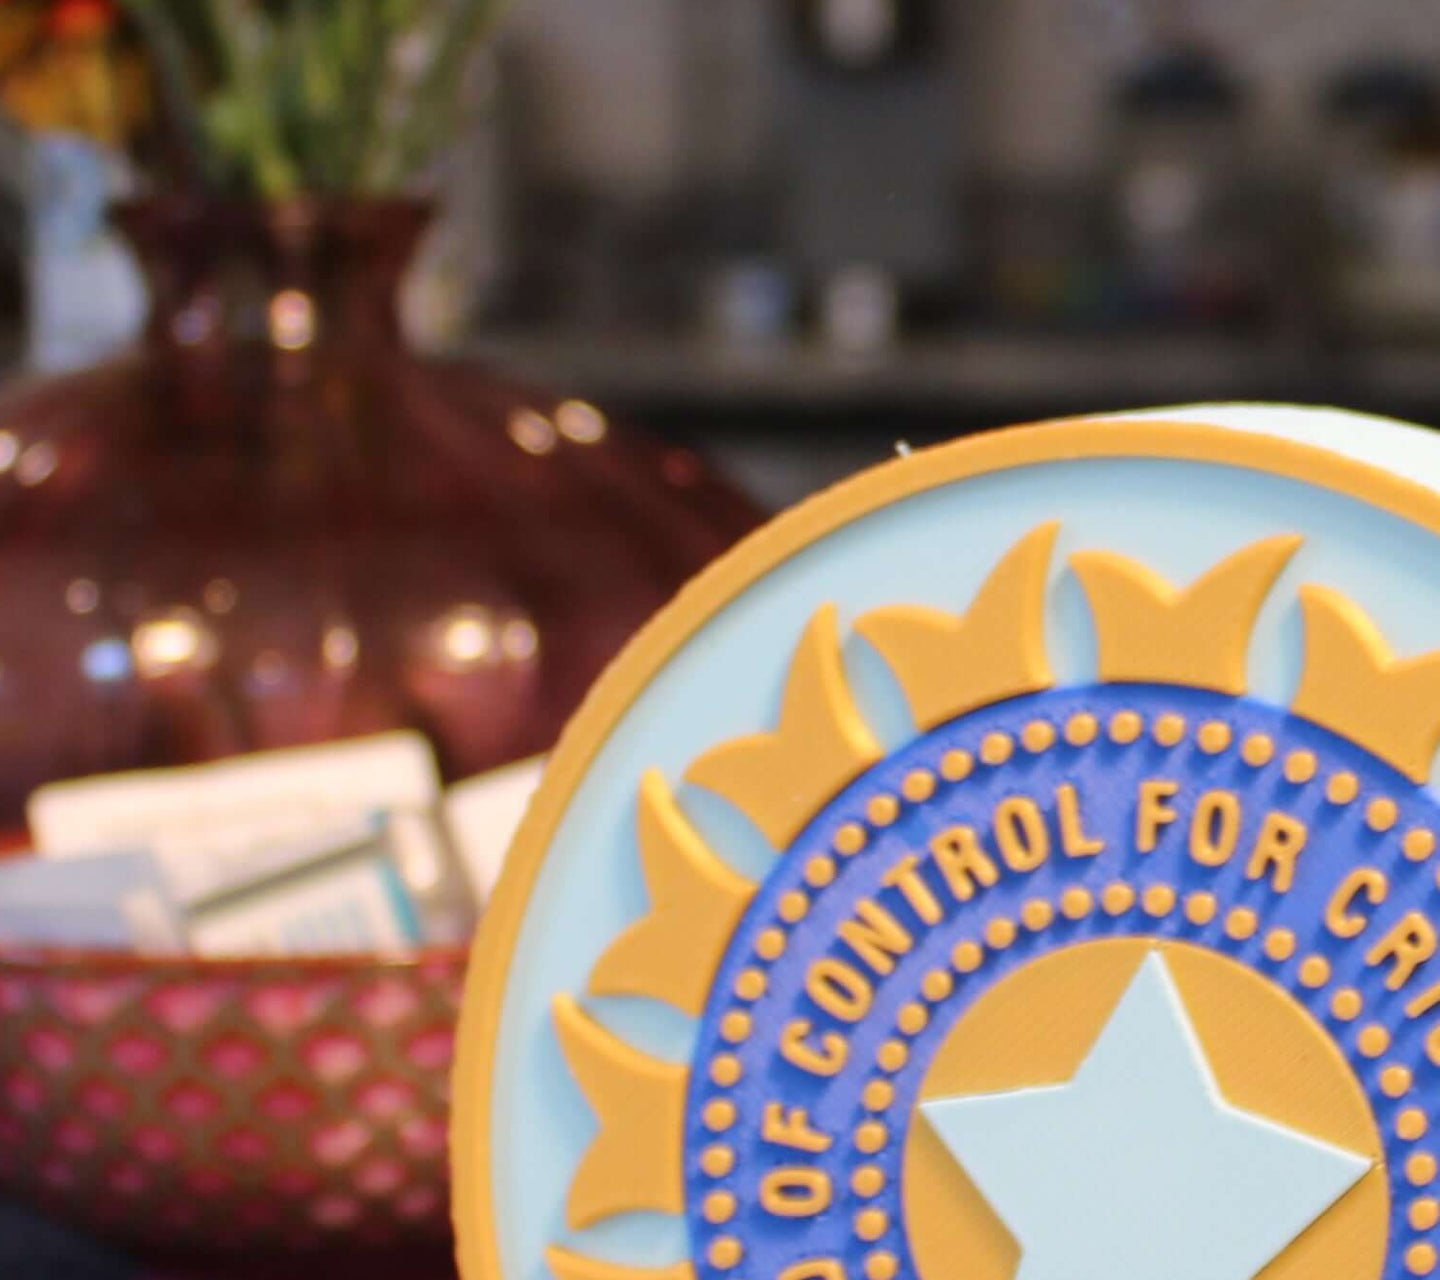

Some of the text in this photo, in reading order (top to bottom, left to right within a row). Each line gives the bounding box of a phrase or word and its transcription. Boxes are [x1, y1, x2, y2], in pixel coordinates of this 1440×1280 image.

[1136, 779, 1309, 893] FOR
[779, 783, 1106, 1076] CONTROL
[760, 1102, 834, 1217] OF
